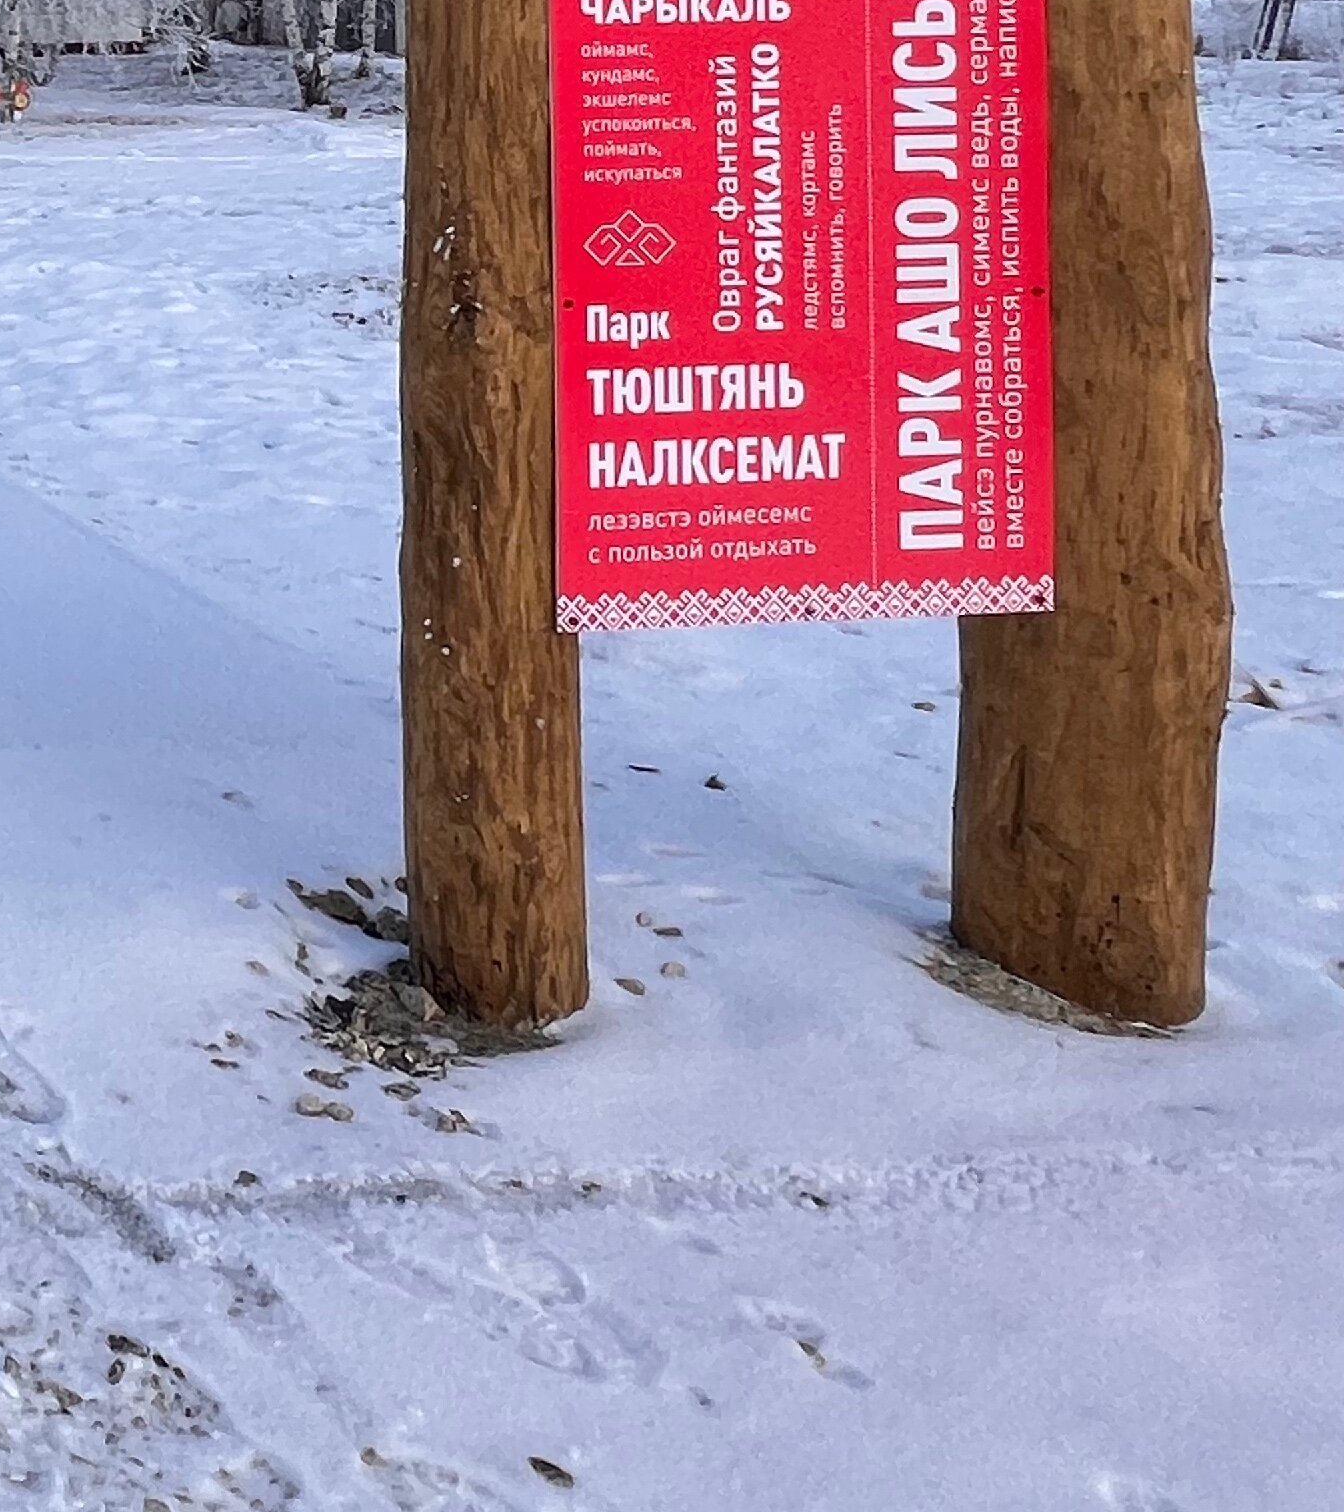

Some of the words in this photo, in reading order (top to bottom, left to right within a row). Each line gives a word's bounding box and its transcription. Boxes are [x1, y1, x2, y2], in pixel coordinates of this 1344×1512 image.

[581, 41, 653, 58] оймамс,
[582, 69, 659, 86] кундамс,
[582, 117, 696, 136] успокоиться,
[583, 93, 671, 107] экшелемс
[709, 57, 746, 221] фантазий
[971, 95, 993, 168] ведь,
[1001, 88, 1022, 167] воды,
[584, 141, 661, 157] поймать,
[585, 167, 682, 185] искупаться
[747, 44, 783, 330] РУСЯЙКАЛАТКО
[801, 131, 821, 216] кортамс
[829, 105, 847, 200] говорить
[972, 179, 990, 285] симемс
[1001, 178, 1019, 275] испить
[713, 231, 747, 331] Овраг
[803, 225, 821, 330] ледстямс,
[830, 209, 846, 329] вспомнить,
[895, 198, 961, 352] АШО
[587, 305, 670, 348] Парк
[998, 287, 1027, 439] собраться,
[587, 363, 804, 415] ТЮШТЯНЬ
[975, 297, 1000, 457] пурнавомс,
[590, 433, 845, 488] НАЛКСЕМАТ
[898, 369, 963, 549] ПАРК
[1006, 449, 1024, 547] вместе
[588, 511, 691, 531] лезэвстэ
[699, 505, 811, 526] оймесемс
[971, 469, 995, 549] вейсэ
[589, 548, 600, 563] с
[609, 538, 703, 562] пользой
[711, 539, 816, 561] отдыхать
